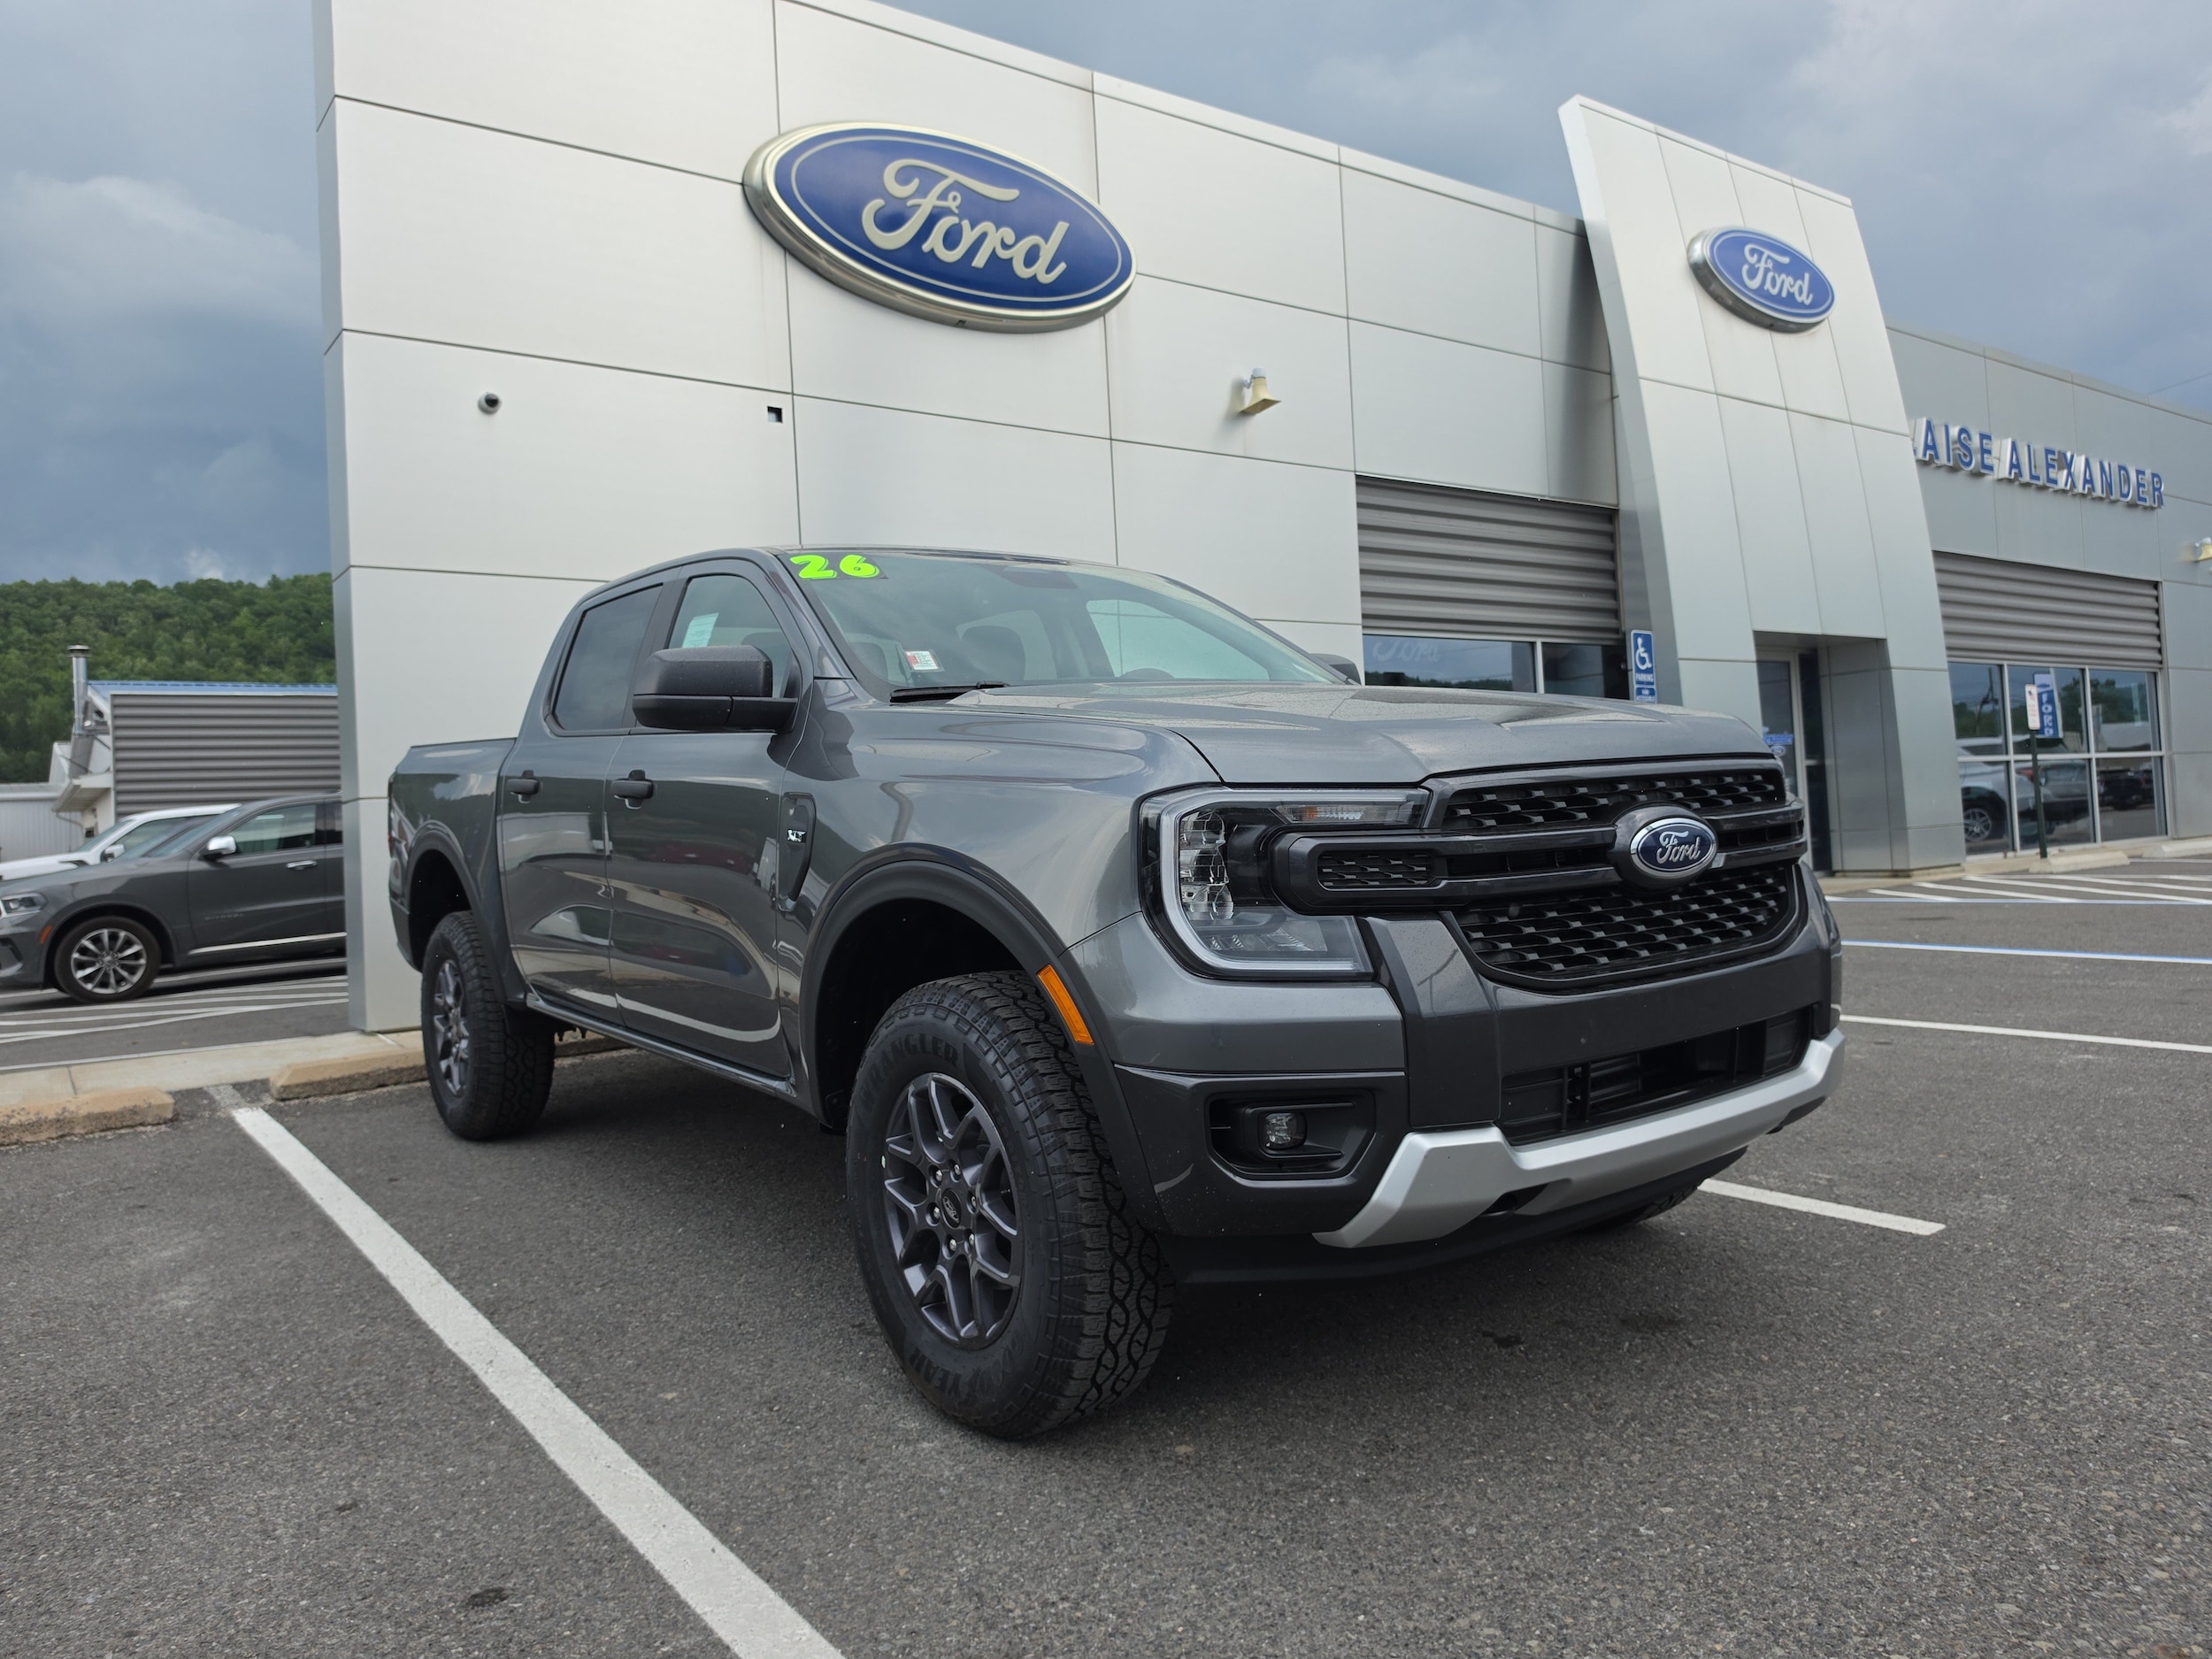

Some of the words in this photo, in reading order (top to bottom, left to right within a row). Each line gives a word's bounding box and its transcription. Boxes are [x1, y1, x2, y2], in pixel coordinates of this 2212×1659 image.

[861, 158, 1070, 285] Ford
[1741, 243, 1814, 306] Ford
[1913, 418, 1994, 475] AISE
[2006, 438, 2164, 508] ALEXANDER
[790, 554, 880, 580] 26
[1656, 830, 1701, 864] Ford
